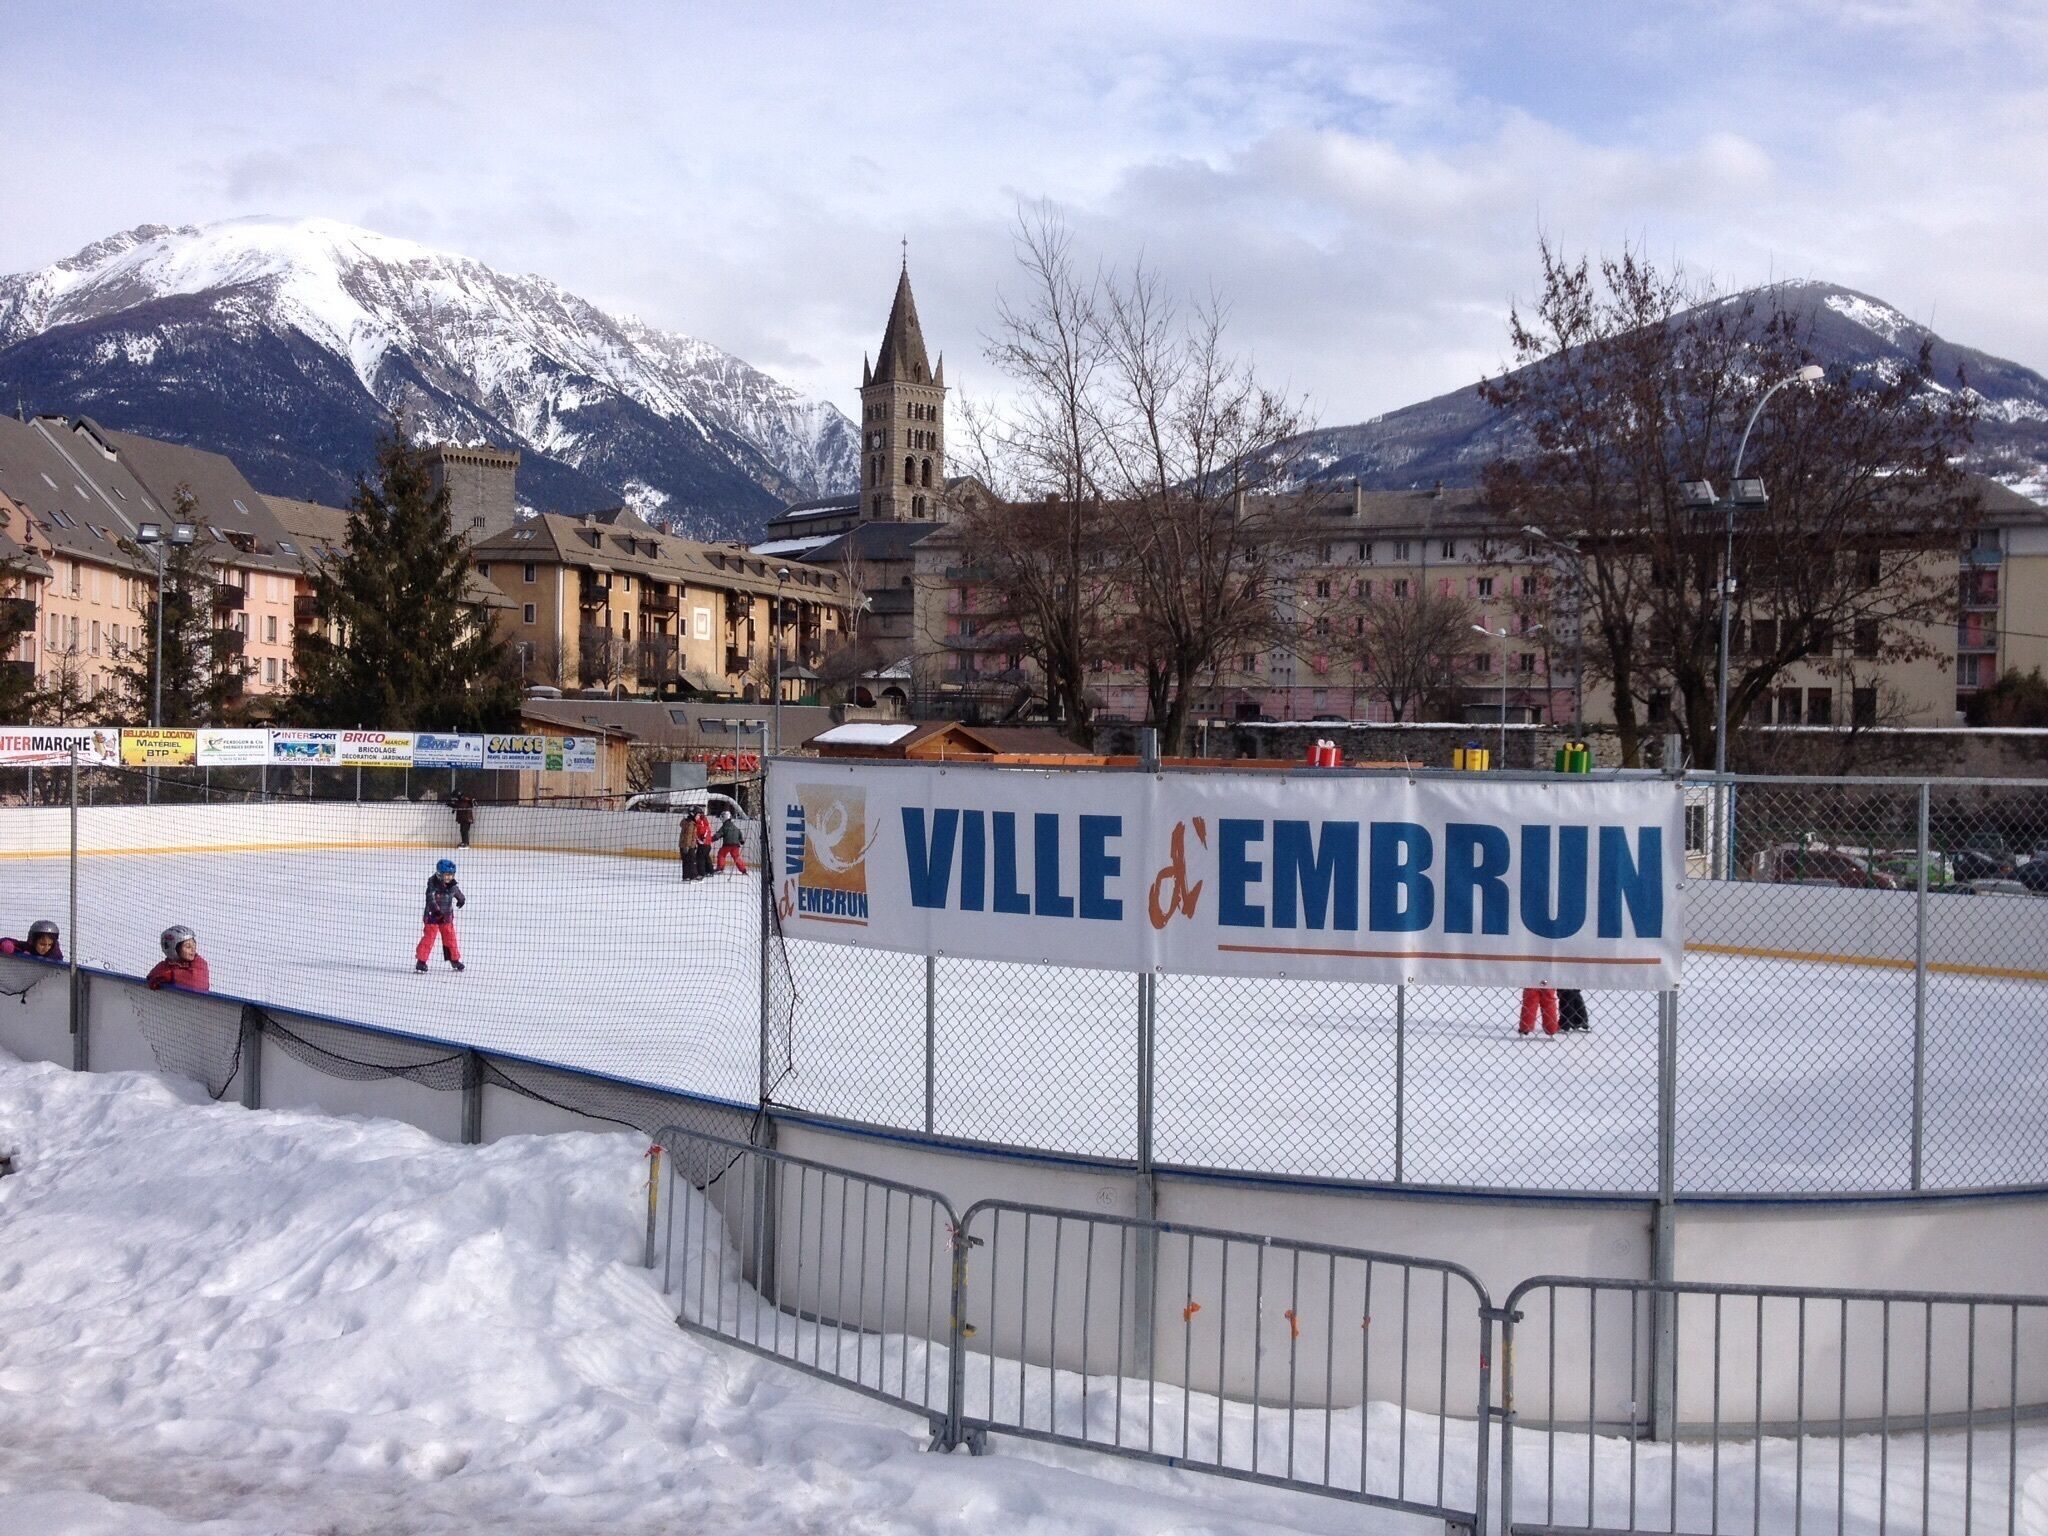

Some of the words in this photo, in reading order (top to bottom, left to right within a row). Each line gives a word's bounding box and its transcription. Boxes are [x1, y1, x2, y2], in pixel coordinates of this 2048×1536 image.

[162, 731, 195, 739] LOCATION
[282, 732, 337, 740] INTERSPORT
[342, 732, 386, 743] BRICO
[487, 736, 543, 754] SAMSE
[146, 749, 169, 757] BTP
[786, 804, 805, 875] VILLE
[901, 807, 1123, 920] VILLE
